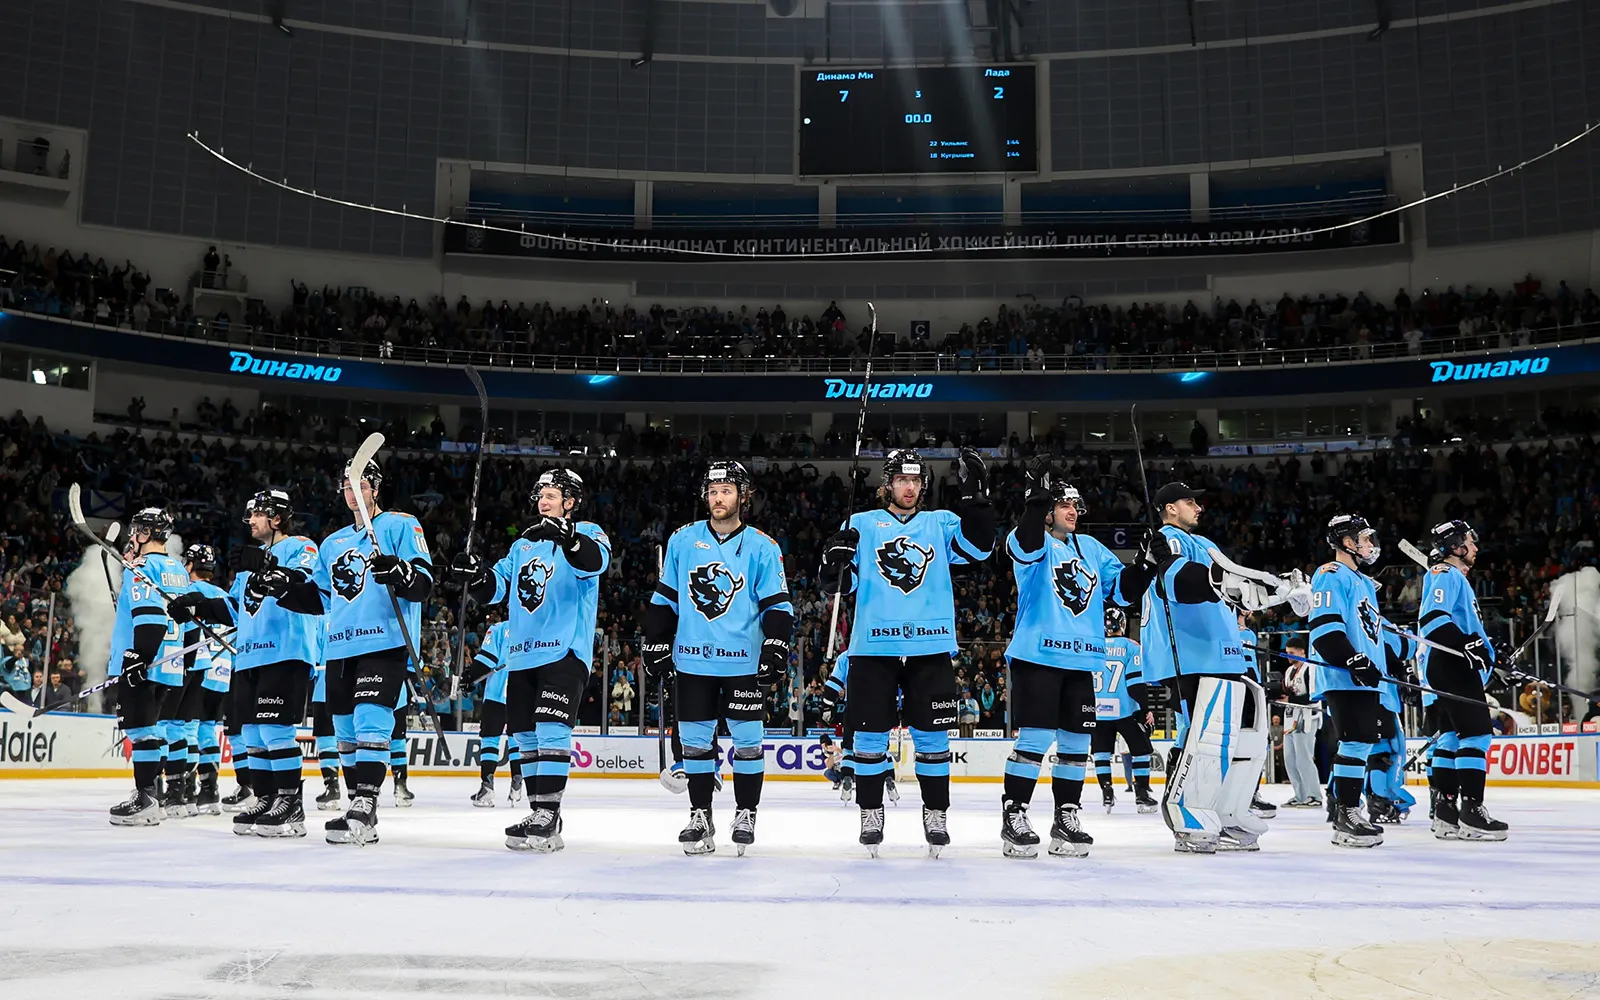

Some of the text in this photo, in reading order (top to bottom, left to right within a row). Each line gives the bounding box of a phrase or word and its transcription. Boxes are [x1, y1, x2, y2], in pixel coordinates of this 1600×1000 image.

[816, 71, 874, 82] Динамо Мн
[984, 68, 1011, 78] Лада
[839, 90, 850, 103] 7
[915, 90, 922, 99] 3
[993, 86, 1004, 99] 2
[904, 113, 932, 124] 00.0
[519, 235, 600, 252] ФОНБЕТ
[733, 232, 931, 253] КОНТИНЕНТАЛЬНОЙ
[938, 231, 1058, 250] ХОККЕЙНОЙ
[1066, 234, 1117, 249] ЛИГИ
[229, 351, 342, 382] Динамо
[1430, 357, 1549, 382] Динамо
[824, 378, 933, 399] Динамо
[414, 535, 430, 554] 10
[131, 584, 151, 602] 67
[1434, 588, 1444, 604] 9
[355, 626, 385, 637] Bank
[871, 626, 949, 637] BSB Bank
[253, 641, 276, 650] Bank
[534, 639, 561, 649] Bank
[1043, 638, 1072, 650] BSB
[678, 644, 749, 658] BSB Bank
[356, 674, 383, 685] Belavia
[78, 676, 120, 699] CCM
[354, 690, 380, 698] CCM
[258, 696, 284, 705] Belavia
[541, 690, 570, 705] Belavia
[596, 754, 645, 769] belbet
[1485, 742, 1575, 775] FONBET
